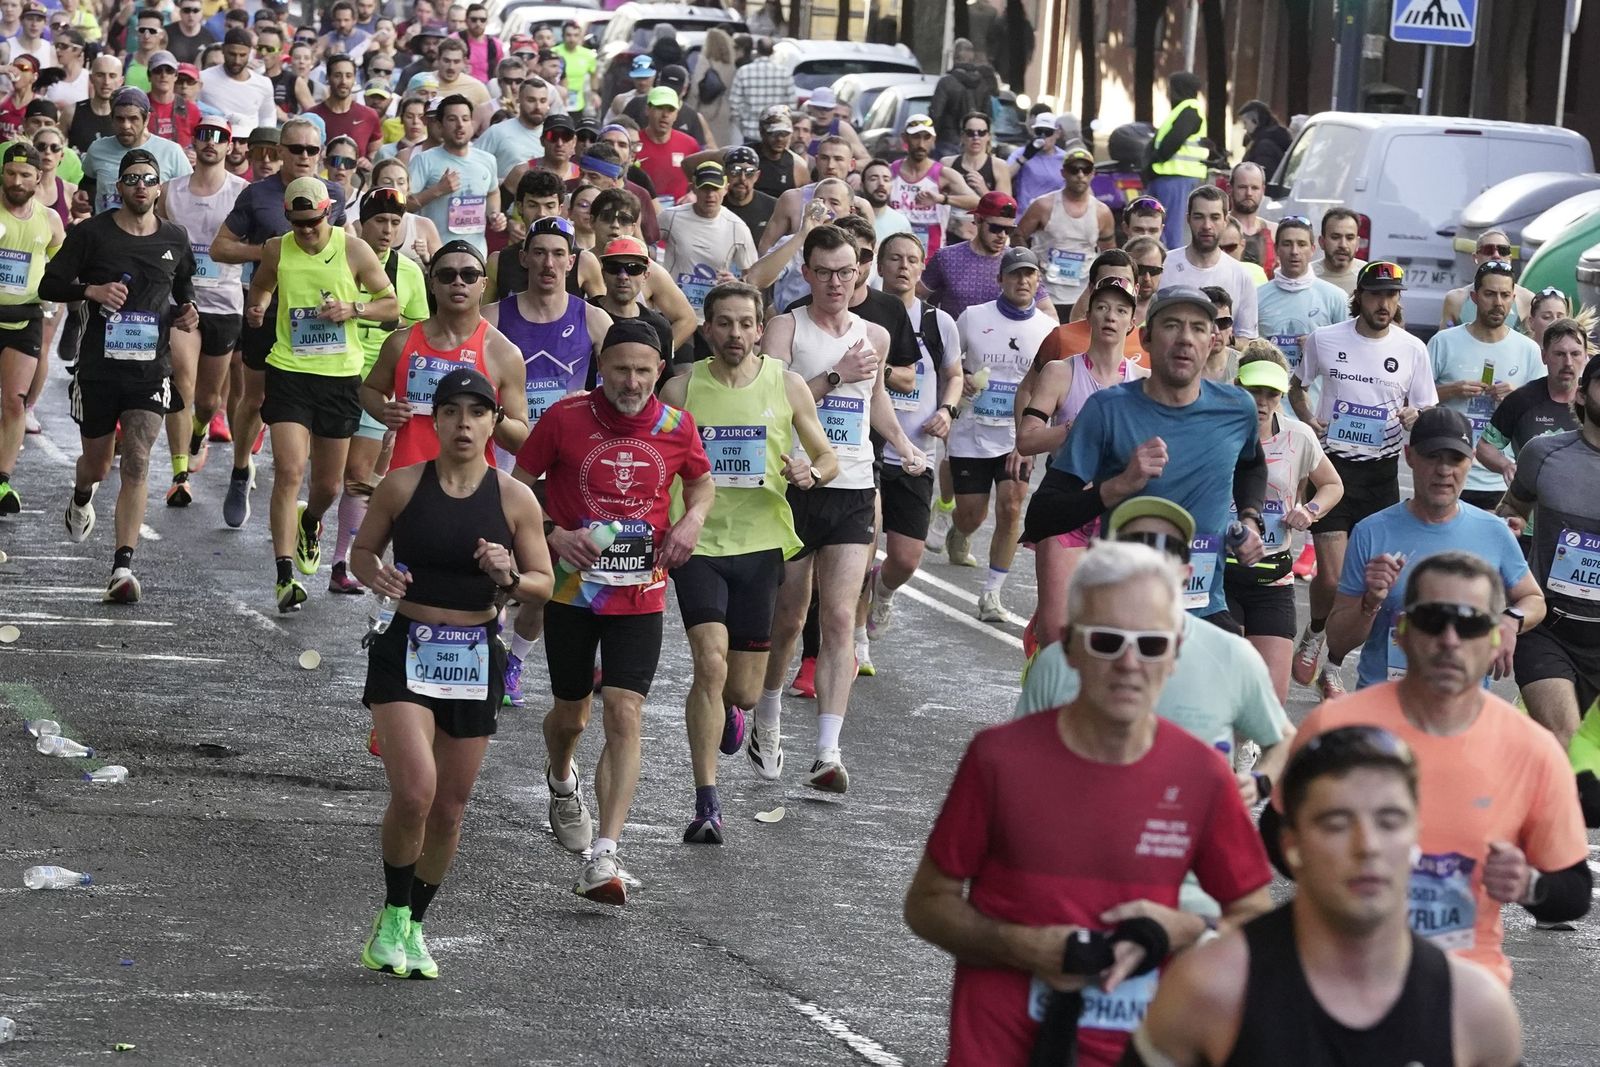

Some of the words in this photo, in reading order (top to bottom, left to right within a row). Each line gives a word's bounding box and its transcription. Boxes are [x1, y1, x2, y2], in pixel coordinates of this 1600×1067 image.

[125, 314, 155, 322] ZURICH
[299, 332, 338, 344] JUANPA
[430, 360, 467, 372] ZURIC
[526, 380, 559, 389] ZURICH
[527, 397, 545, 405] 9685
[828, 399, 859, 410] ZURICH
[1351, 406, 1382, 417] ZURICH
[826, 416, 845, 425] 8382
[1349, 421, 1366, 430] 8321
[720, 428, 760, 438] ZURICH
[824, 428, 848, 442] ACK
[1337, 428, 1375, 444] DANIEL
[722, 446, 742, 456] 6767
[714, 459, 751, 472] AITOR
[609, 543, 632, 553] 4827
[1186, 576, 1206, 591] IK
[437, 630, 481, 641] ZURICH
[436, 651, 460, 662] 5481
[415, 663, 480, 682] CLAUDIA
